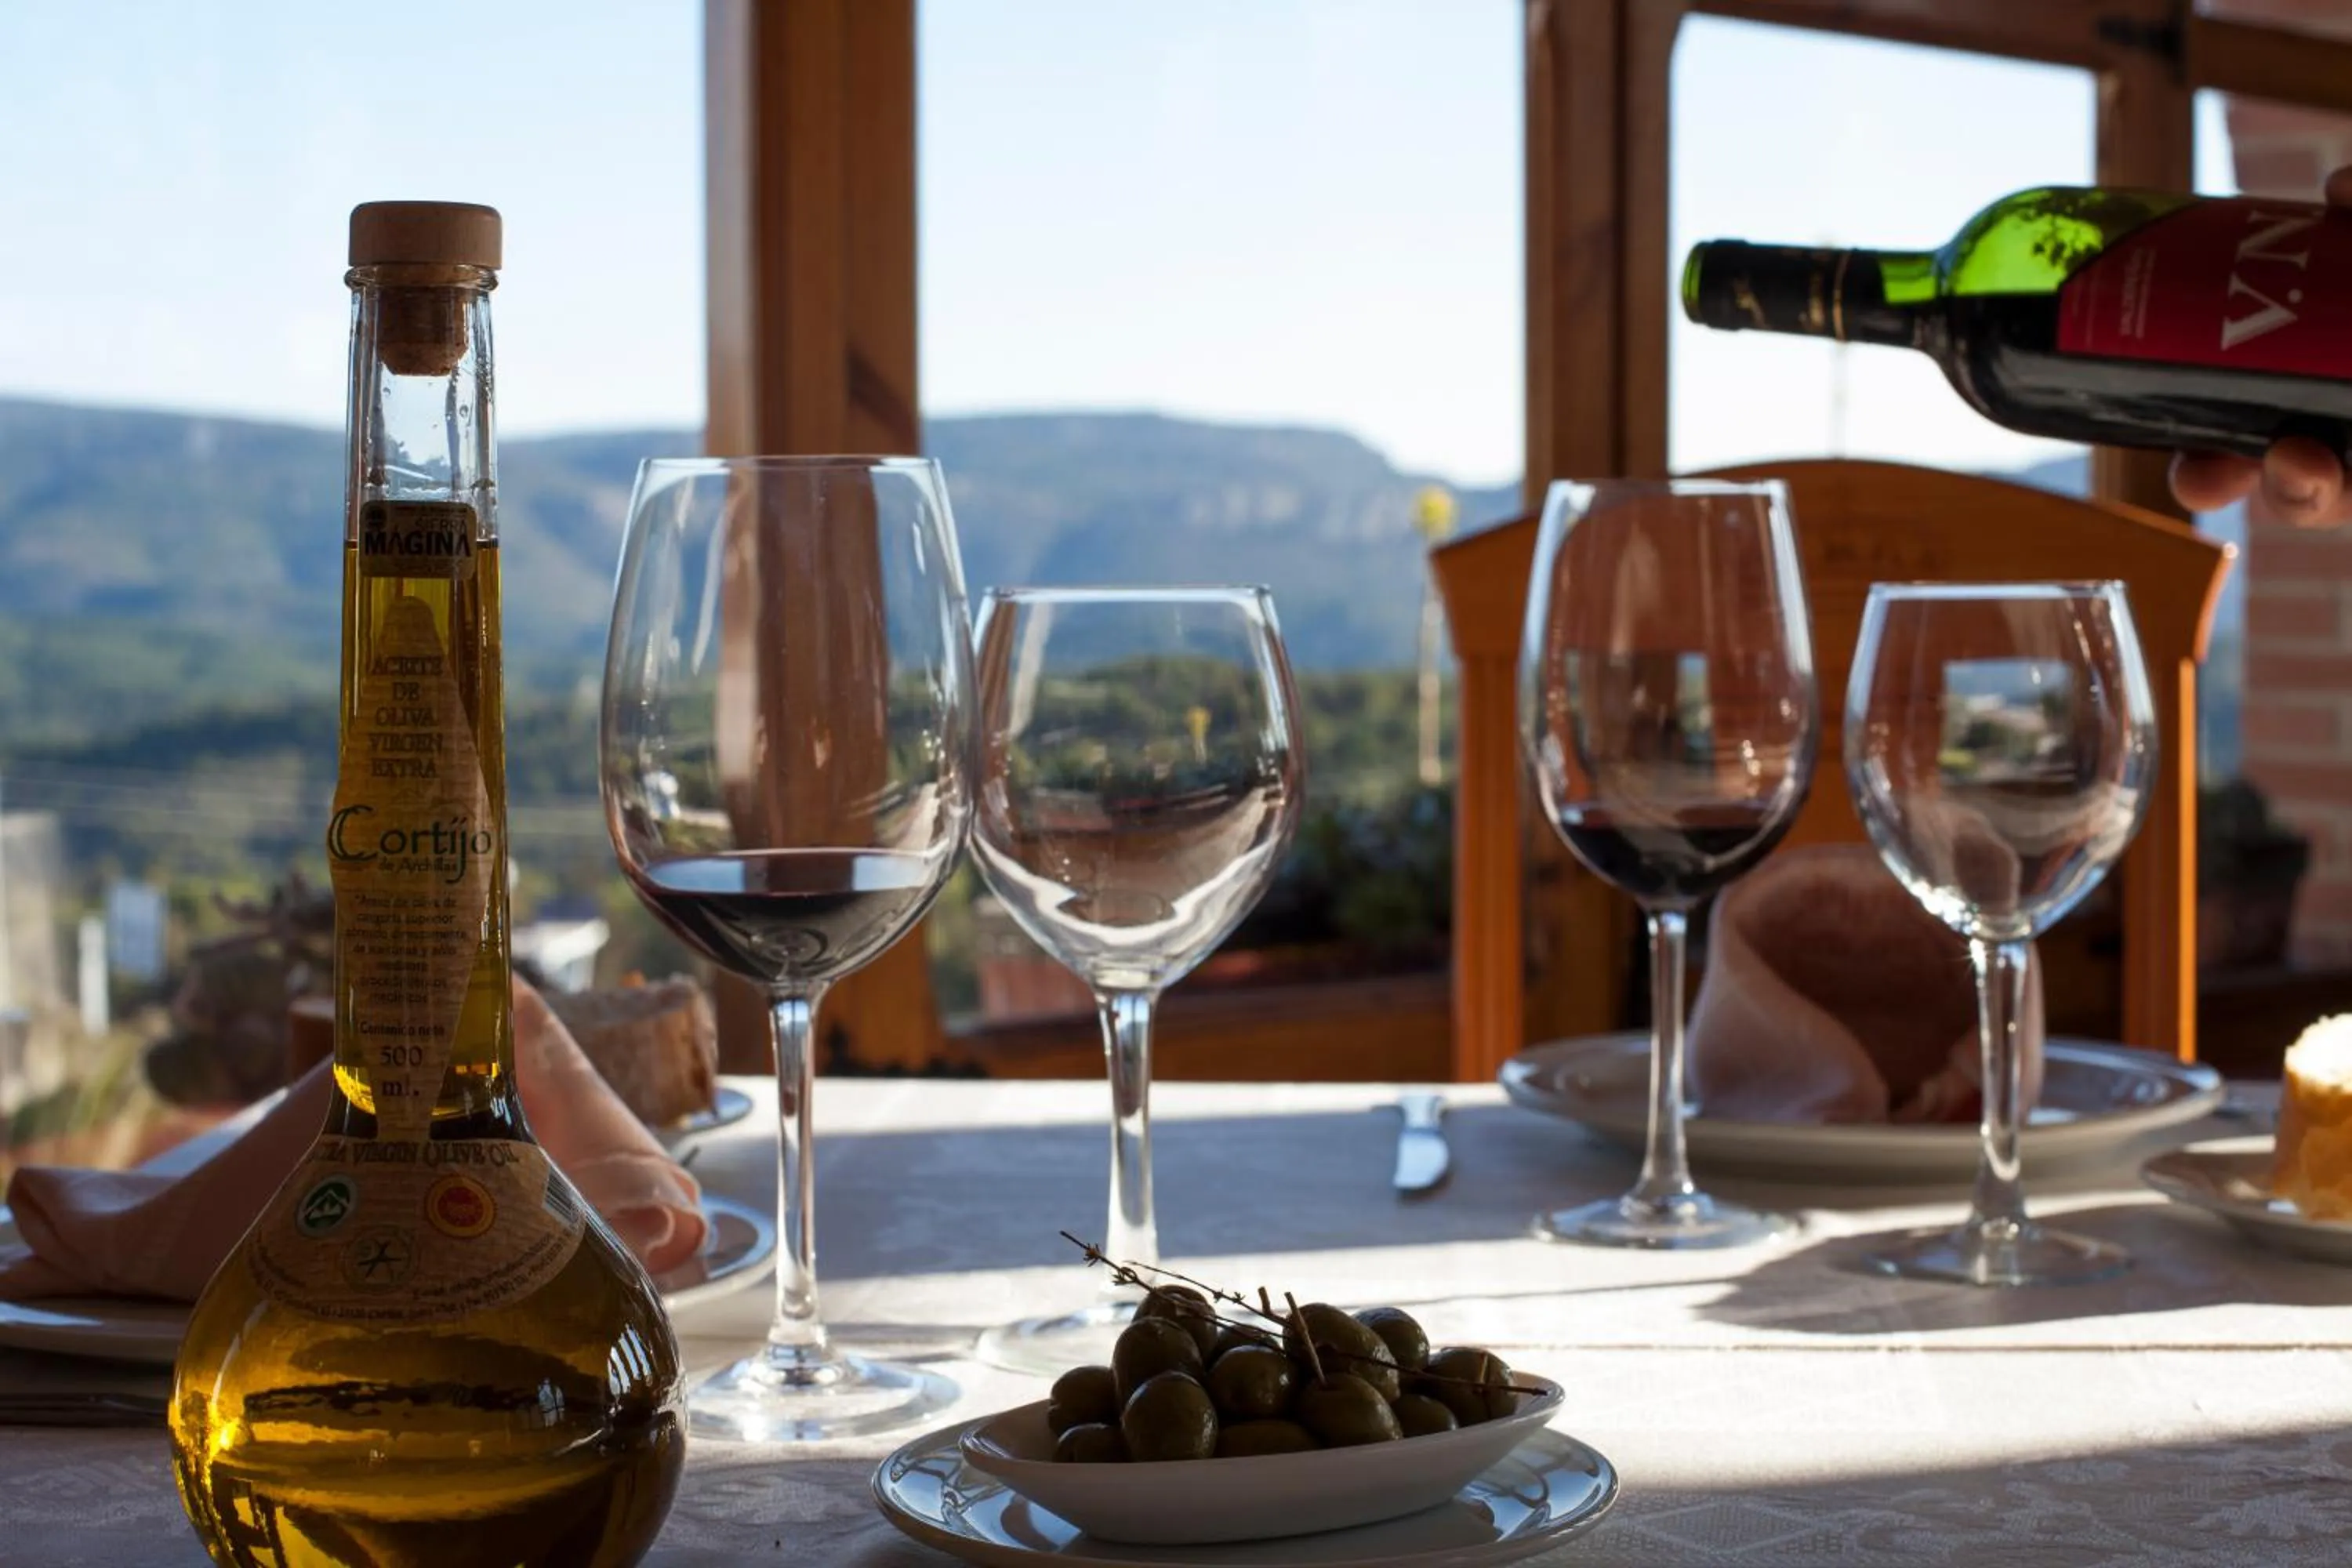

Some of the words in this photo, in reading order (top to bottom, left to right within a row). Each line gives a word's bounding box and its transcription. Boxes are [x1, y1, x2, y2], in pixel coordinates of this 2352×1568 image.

[376, 707, 439, 727] OLIVA
[368, 733, 443, 753] VIRGEN
[371, 758, 440, 778] EXTRA
[328, 804, 492, 884] Cortijo
[379, 1045, 423, 1067] 500
